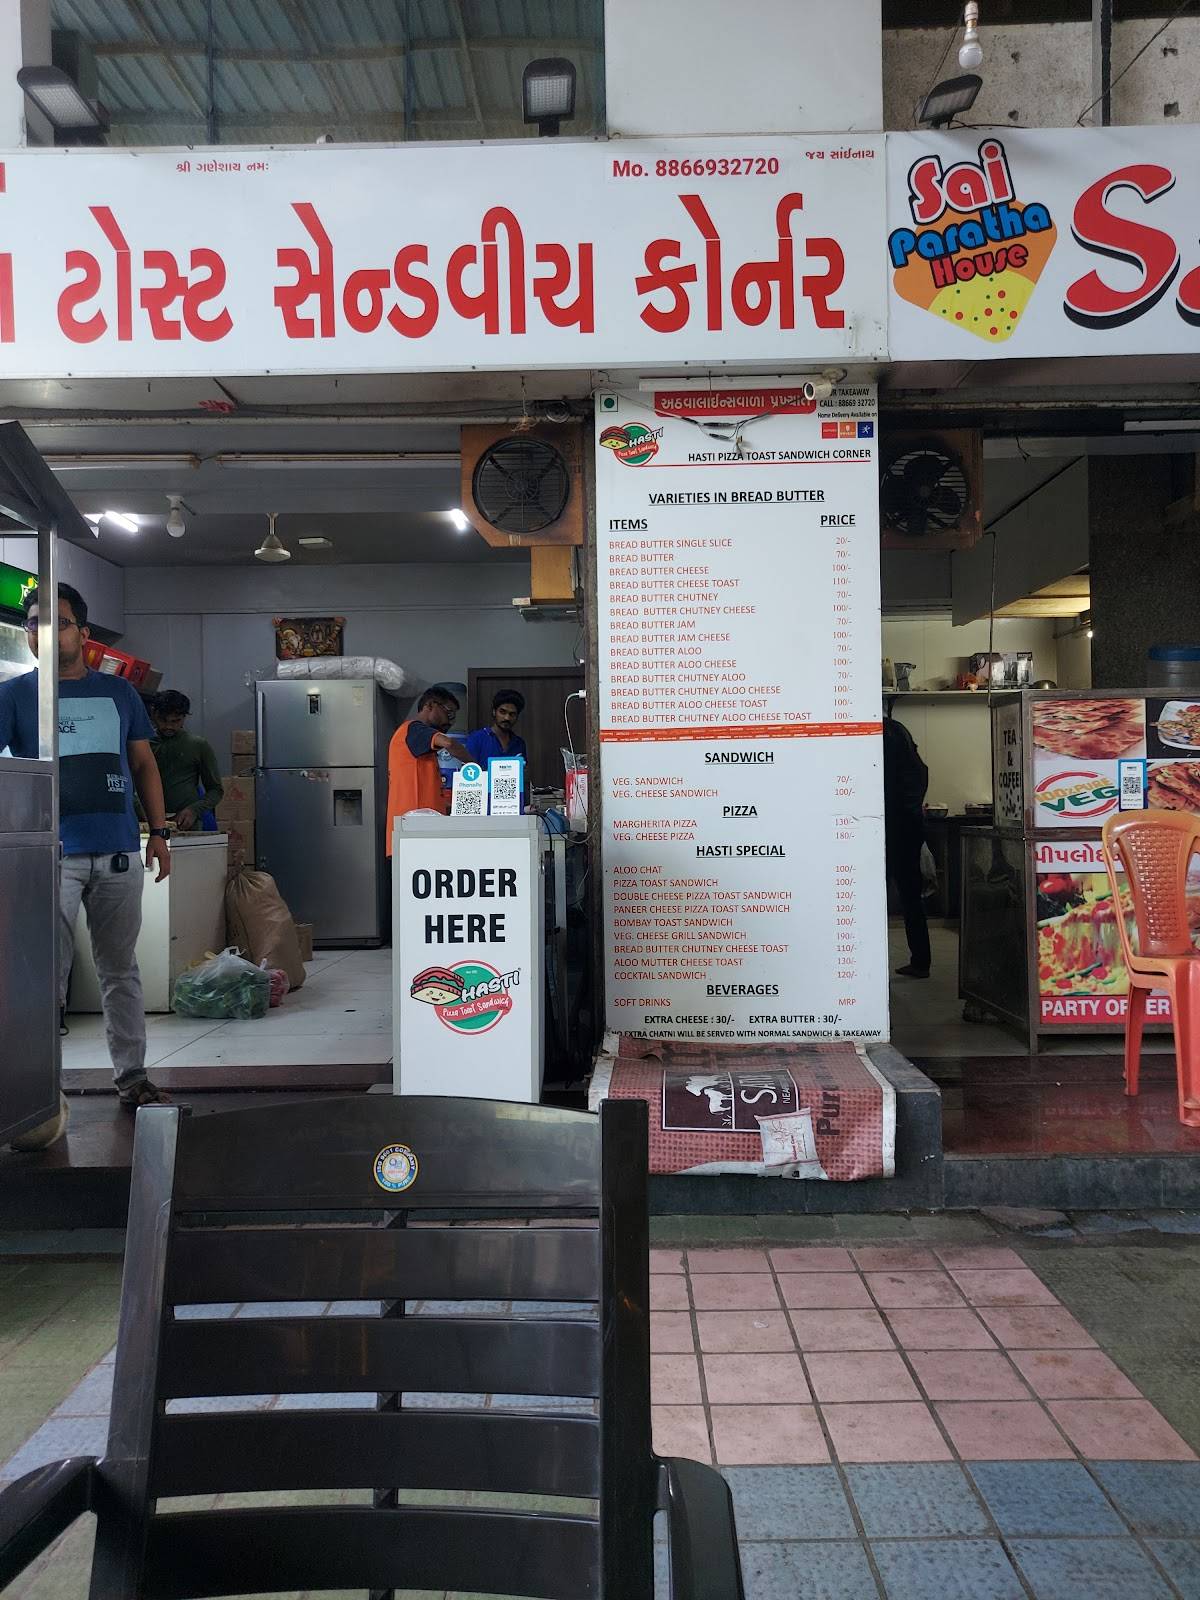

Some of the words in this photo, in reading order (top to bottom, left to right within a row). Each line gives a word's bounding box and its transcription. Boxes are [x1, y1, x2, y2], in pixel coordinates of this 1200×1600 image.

[805, 151, 825, 159] જય
[176, 160, 190, 172] શ્રી
[196, 160, 241, 172] ગણેશાય
[613, 160, 649, 177] Mo.
[655, 157, 779, 176] 8866932720
[908, 139, 1016, 225] Sai
[888, 201, 1052, 268] Paratha
[57, 206, 234, 344] ટોસ્ટ
[635, 192, 845, 333] કોર્નર
[930, 243, 1028, 288] House
[838, 388, 870, 396] TAKEAWAY
[820, 399, 833, 407] CALL
[629, 428, 664, 448] HASTI
[688, 452, 714, 461] HASTI
[718, 452, 745, 461] PIZZA
[745, 451, 776, 460] TOAST
[778, 450, 829, 459] SANDWICH
[832, 449, 870, 458] CORNER
[648, 492, 710, 503] VARIETIES
[714, 492, 726, 502] IN
[731, 491, 772, 502] BREAD
[776, 490, 824, 501] BUTTER
[609, 519, 647, 530] ITEMS
[820, 514, 855, 525] PRICE
[609, 540, 639, 549] BREAD
[640, 539, 674, 548] BUTTER
[676, 539, 707, 548] SINGLE
[709, 538, 732, 547] SLICE
[609, 554, 640, 562] BREAD
[640, 553, 676, 562] BUTTER
[609, 580, 640, 589] BREAD
[639, 580, 674, 588] BUTTER
[676, 579, 709, 588] CHEESE
[710, 578, 739, 587] TOAST
[609, 607, 639, 616] BREAD
[643, 606, 677, 615] BUTTER
[679, 606, 721, 615] CHUTNEY
[722, 605, 755, 614] CHEESE
[610, 621, 638, 629] BREAD
[641, 620, 674, 629] BUTTER
[675, 620, 695, 628] JAM
[611, 701, 641, 709] BREAD
[642, 700, 675, 709] BUTTER
[677, 700, 702, 708] ALOO
[704, 700, 736, 708] CHEESE
[738, 699, 767, 708] TOAST
[611, 714, 639, 723] BREAD
[642, 714, 677, 722] BUTTER
[678, 713, 720, 722] CHUTNEY
[721, 713, 747, 721] ALOO
[748, 712, 780, 721] CHEESE
[783, 712, 810, 721] TOAST
[1004, 730, 1016, 745] TEA
[705, 752, 773, 762] SANDWICH
[612, 777, 632, 786] VEG.
[634, 777, 683, 786] SANDWICH
[612, 789, 634, 798] VEG.
[635, 789, 667, 798] CHEESE
[669, 788, 717, 797] SANDWICH
[1040, 786, 1119, 811] VEG
[723, 805, 757, 816] PIZZA
[613, 820, 670, 828] MARGHERITA
[673, 819, 697, 828] PIZZA
[613, 832, 633, 840] VEG.
[635, 832, 667, 840] CHEESE
[670, 832, 694, 840] PIZZA
[696, 845, 732, 856] HASTI
[736, 845, 785, 855] SPECIAL
[613, 866, 638, 874] ALOO
[639, 866, 662, 874] CHAT
[412, 869, 517, 899] ORDER
[613, 879, 638, 887] PIZZA
[638, 879, 667, 887] TOAST
[669, 879, 718, 887] SANDWICH
[611, 892, 649, 900] DOUBLE
[651, 892, 684, 900] CHEESE
[686, 891, 710, 900] PIZZA
[711, 891, 741, 900] TOAST
[742, 891, 791, 900] SANDWICH
[614, 905, 647, 913] PANEER
[649, 905, 683, 913] CHEESE
[684, 904, 708, 913] PIZZA
[710, 904, 740, 913] TOAST
[740, 904, 789, 913] SANDWICH
[614, 918, 651, 927] BOMBAY
[653, 918, 683, 927] TOAST
[683, 918, 732, 926] SANDWICH
[425, 914, 506, 944] HERE
[613, 932, 634, 940] VEG.
[635, 931, 670, 940] CHEESE
[671, 931, 696, 940] GRILL
[696, 931, 746, 940] SANDWICH
[614, 944, 644, 953] BREAD
[645, 944, 680, 953] BUTTER
[681, 944, 724, 952] CHUTNEY
[725, 944, 758, 952] CHEESE
[760, 944, 788, 952] TOAST
[614, 958, 638, 966] ALOO
[641, 958, 678, 966] MUTTER
[678, 958, 713, 966] CHEESE
[715, 958, 742, 966] TOAST
[614, 971, 655, 979] COCKTAIL
[657, 971, 704, 979] SANDWICH
[462, 971, 520, 1002] HASTI
[706, 984, 778, 994] BEVERAGES
[614, 998, 636, 1006] SOFT
[638, 998, 671, 1006] DRINKS
[838, 998, 856, 1006] MRP
[1042, 1000, 1100, 1016] PARTY
[1105, 999, 1170, 1016] OFER
[749, 1015, 778, 1023] EXTRA
[780, 1015, 815, 1023] BUTTER
[822, 1015, 841, 1023] 30/-
